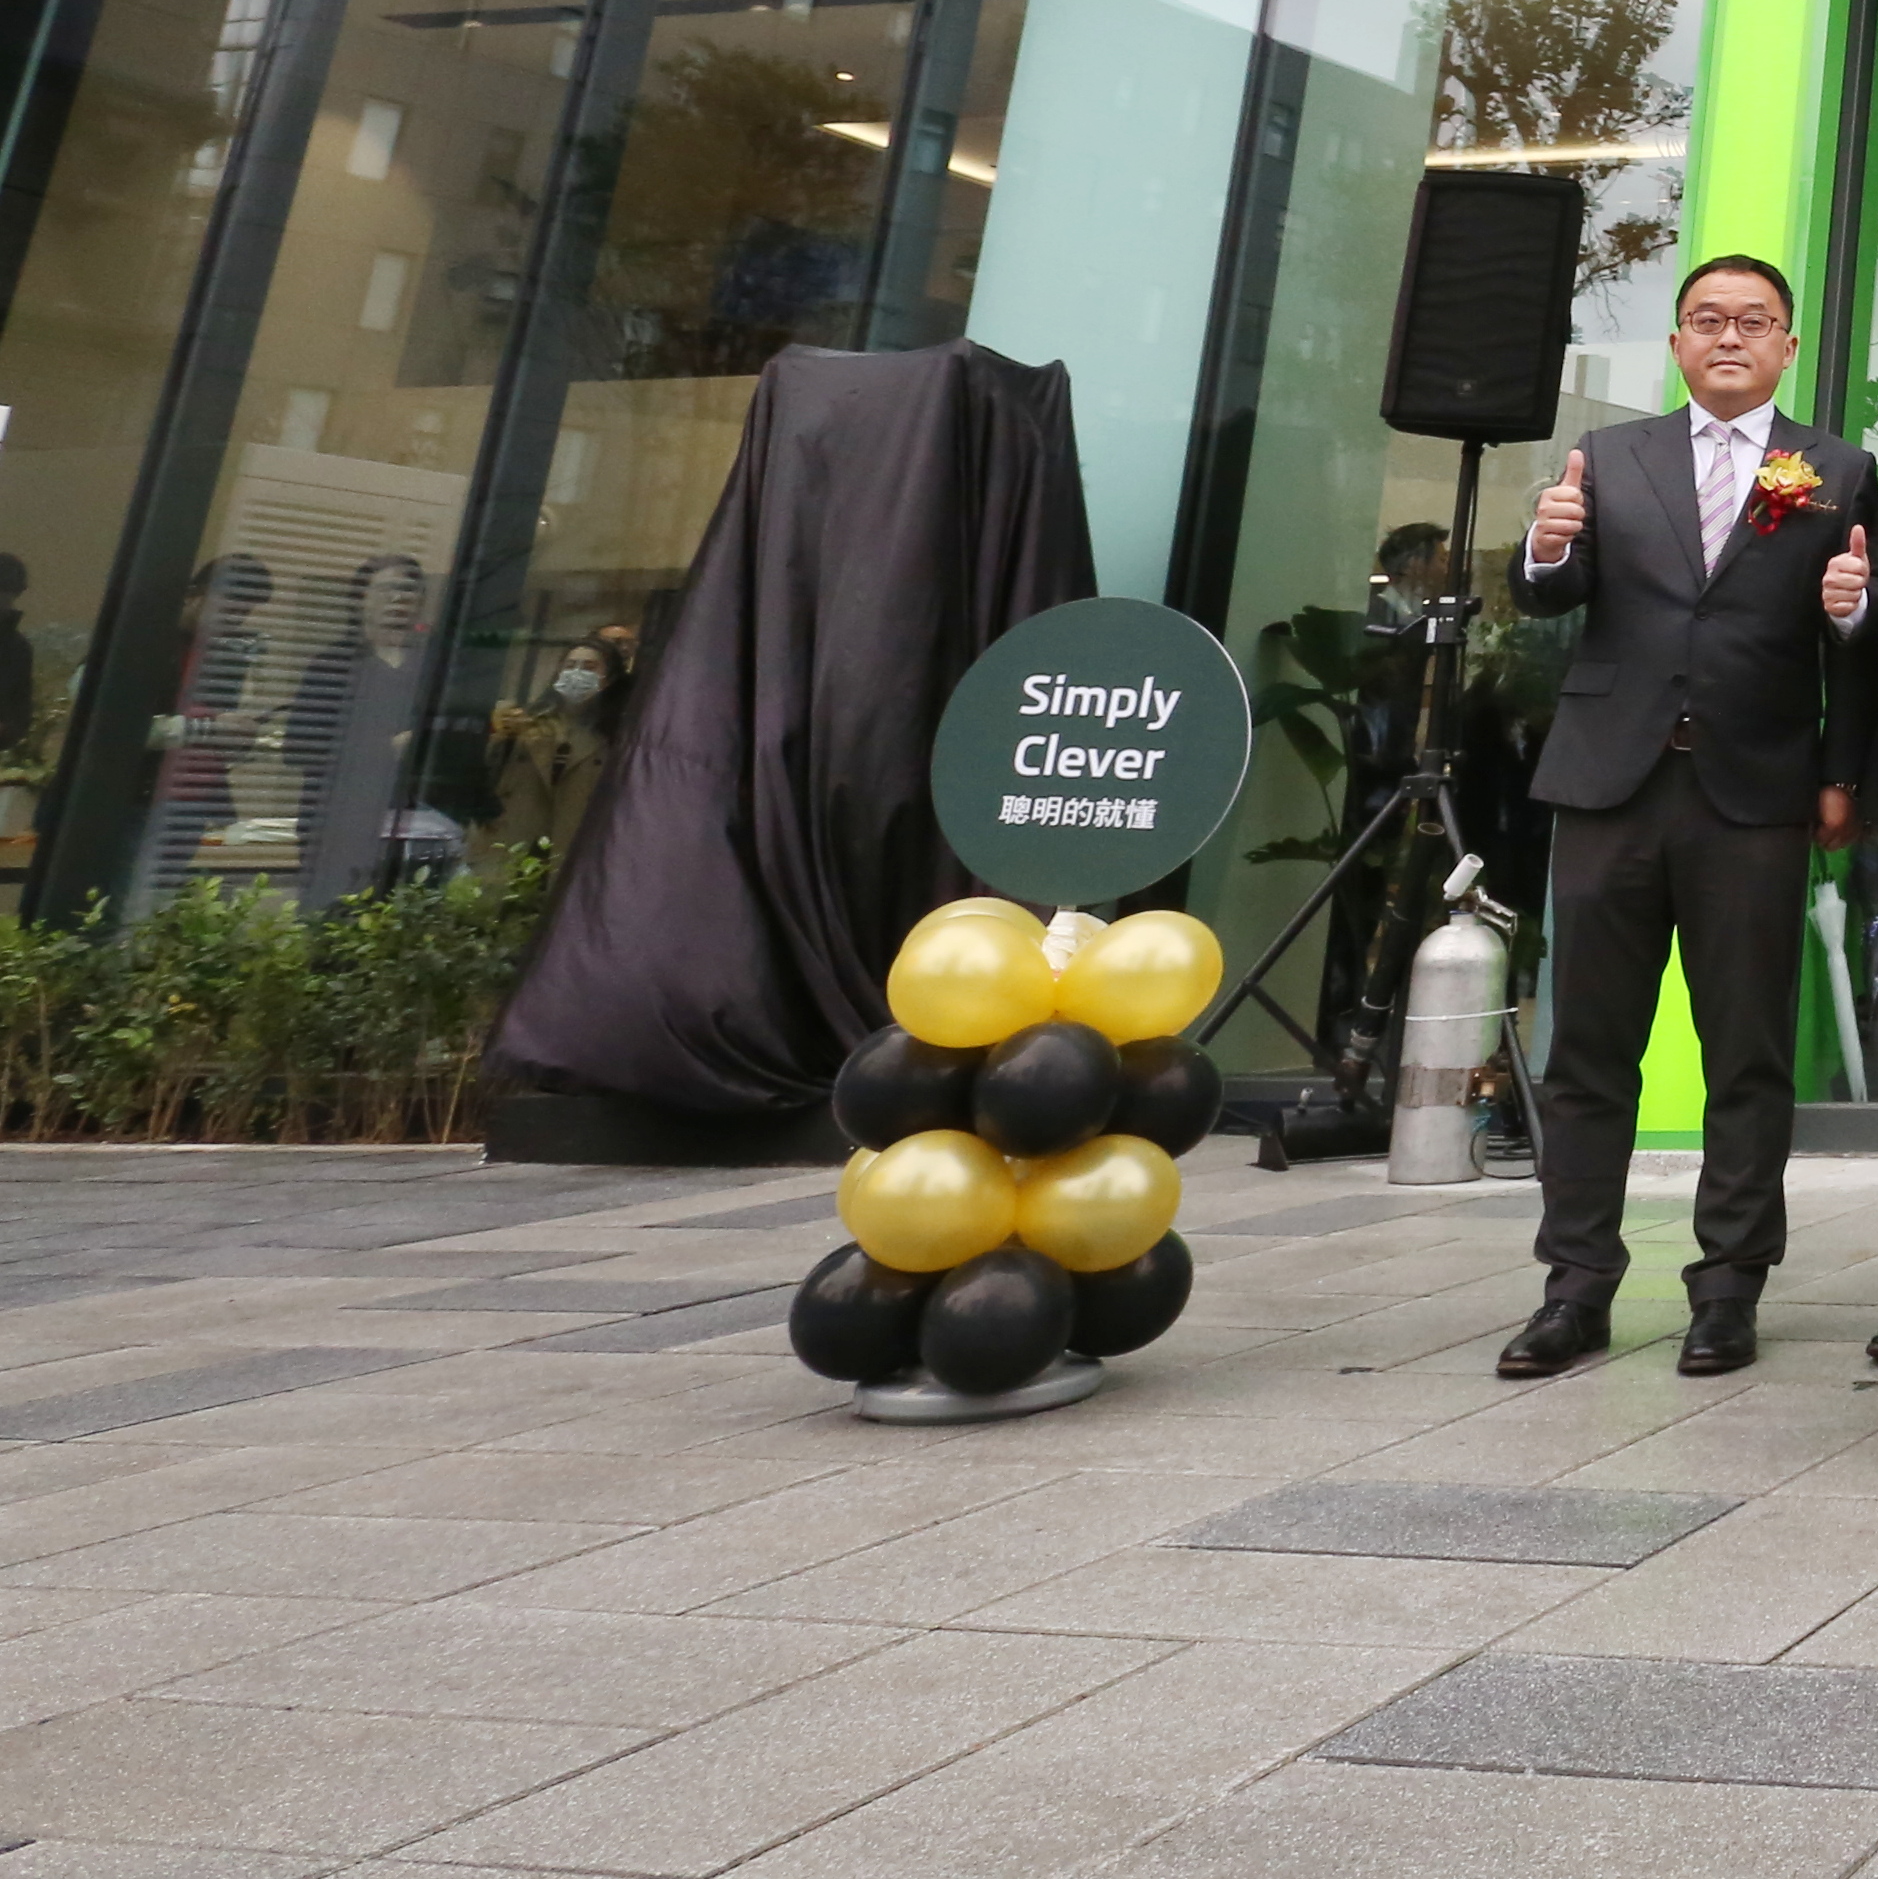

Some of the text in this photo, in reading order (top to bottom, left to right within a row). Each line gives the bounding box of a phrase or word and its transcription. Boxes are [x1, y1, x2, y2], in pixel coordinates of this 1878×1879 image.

[1019, 674, 1182, 731] Simply
[1014, 733, 1166, 779] Clever
[998, 794, 1158, 829] 聰明的就懂
